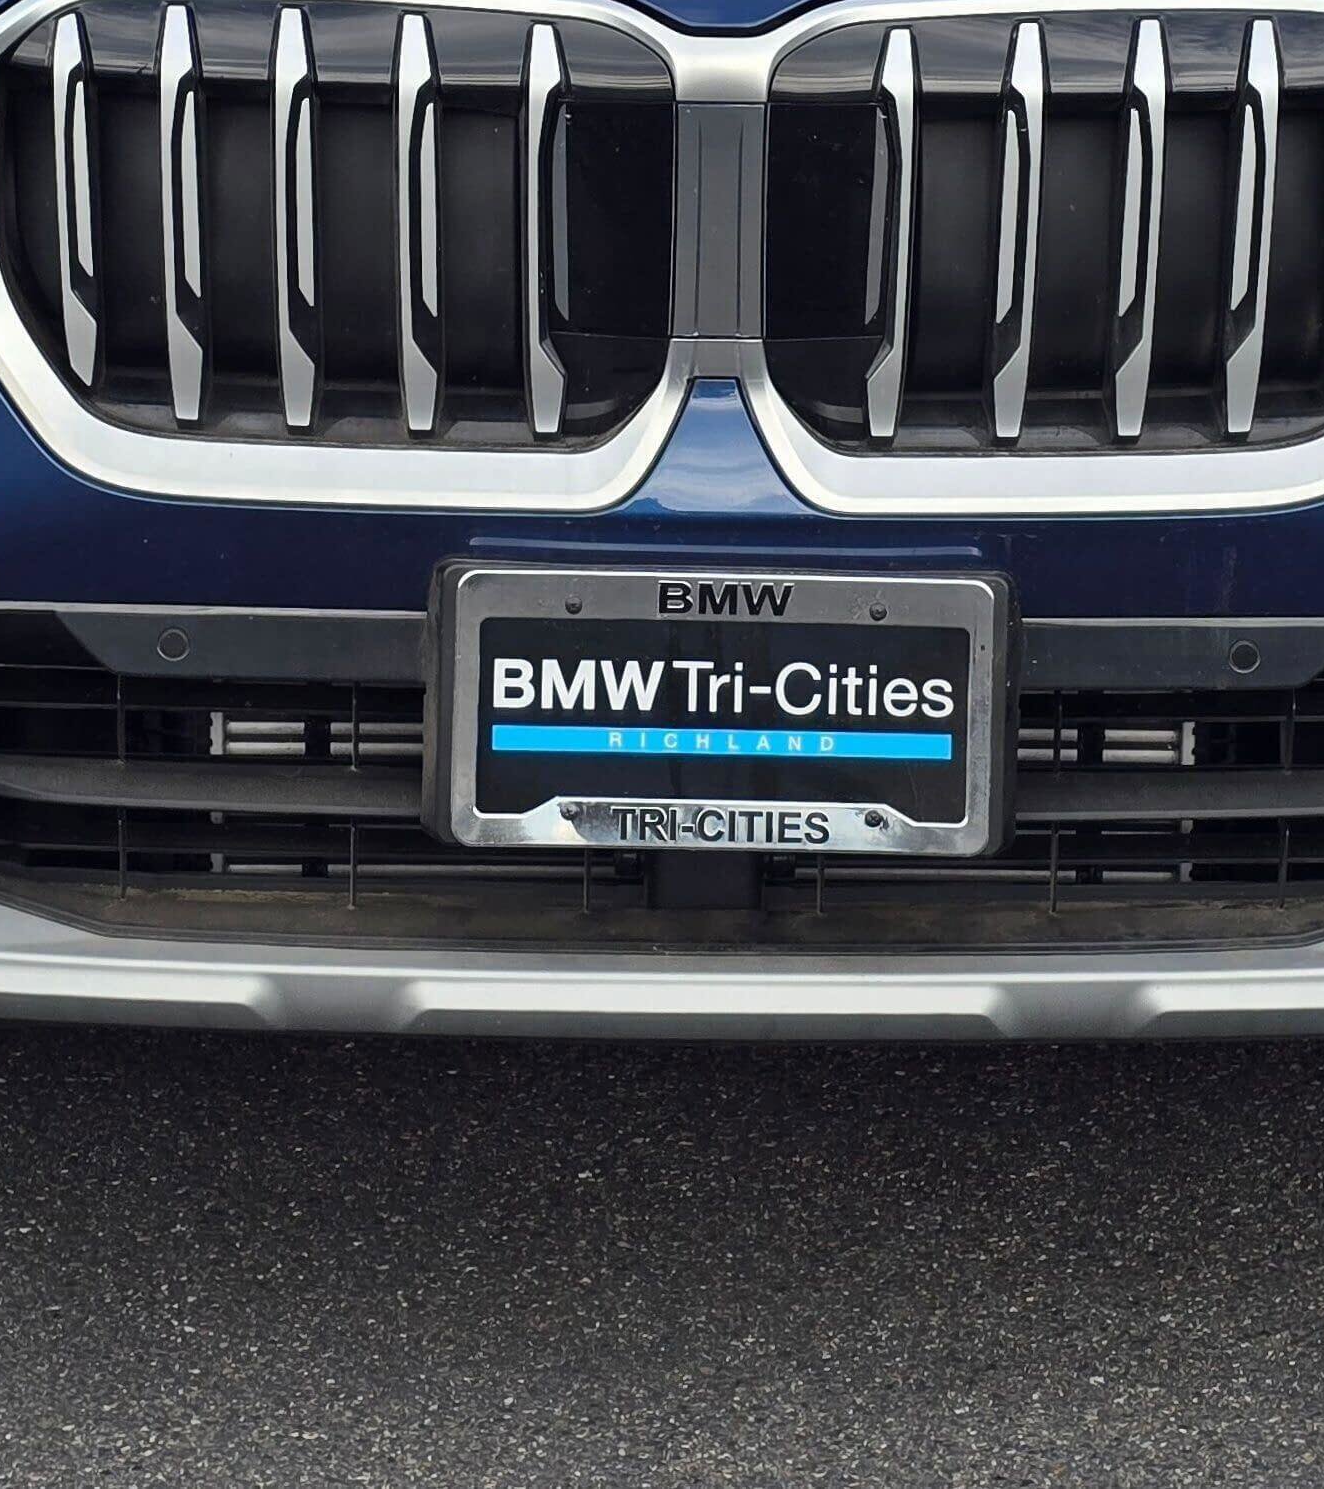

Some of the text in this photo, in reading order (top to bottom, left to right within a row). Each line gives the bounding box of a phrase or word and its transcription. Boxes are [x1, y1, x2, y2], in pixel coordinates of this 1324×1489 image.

[657, 580, 794, 616] BMW
[492, 657, 955, 717] BMW Tri-Cities
[608, 731, 837, 753] RICHLAND
[612, 806, 831, 846] TRI-CITIES
